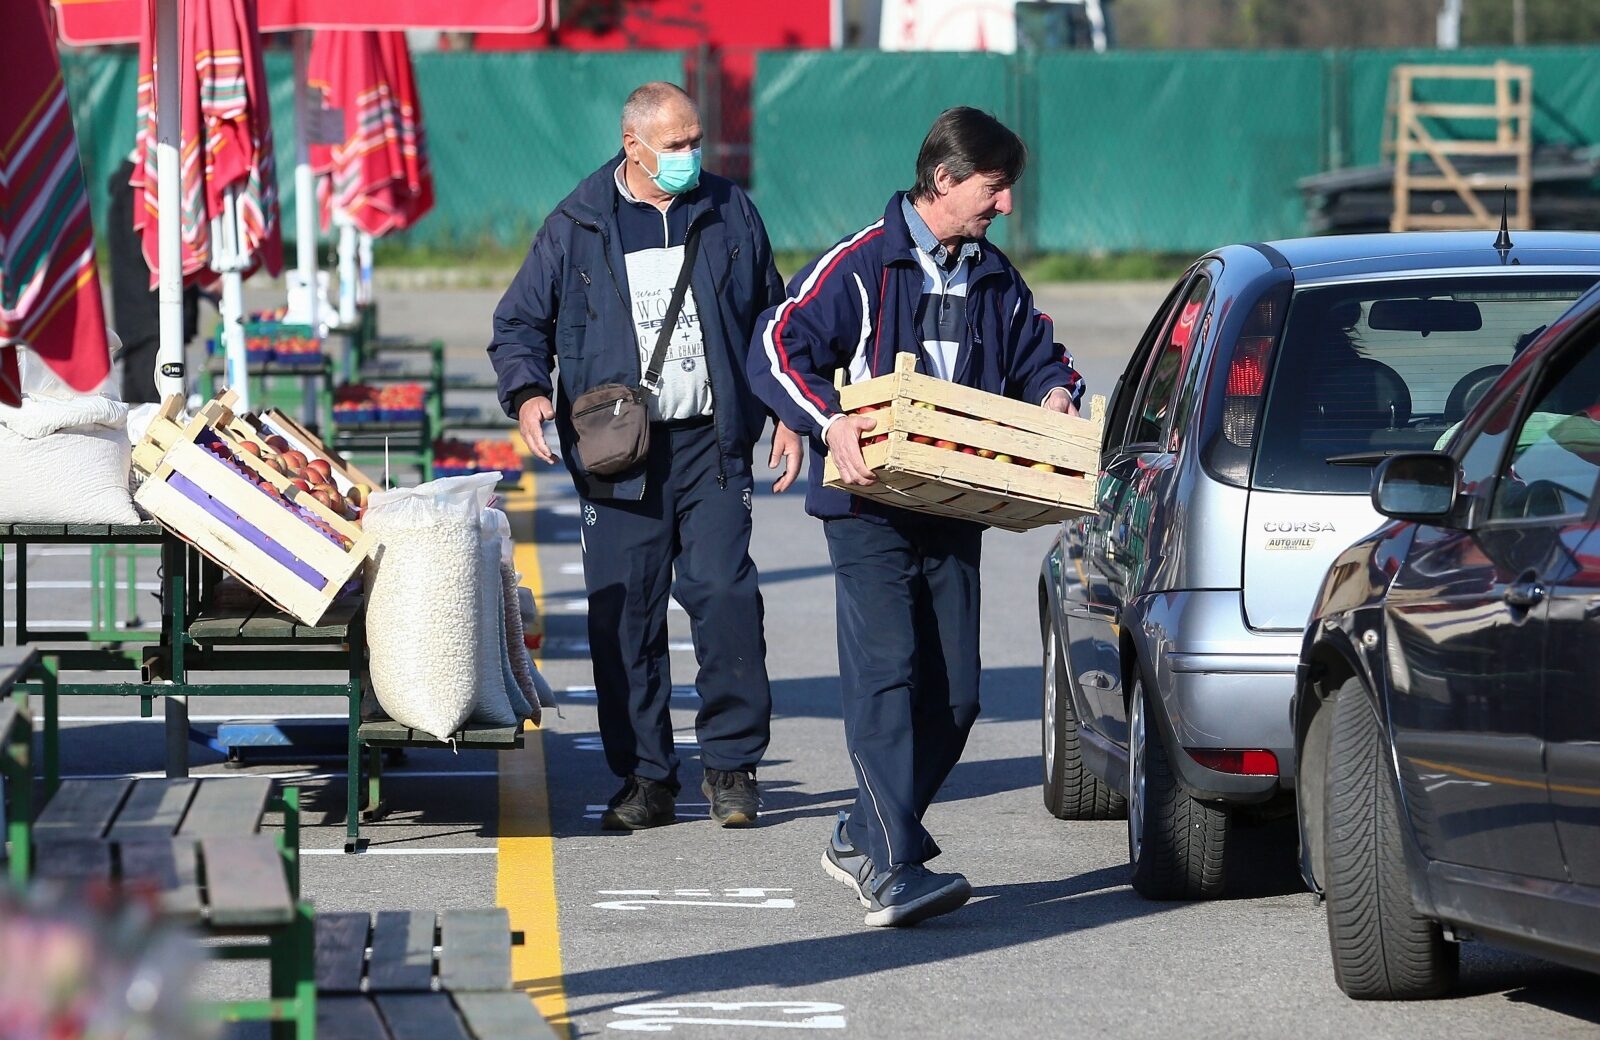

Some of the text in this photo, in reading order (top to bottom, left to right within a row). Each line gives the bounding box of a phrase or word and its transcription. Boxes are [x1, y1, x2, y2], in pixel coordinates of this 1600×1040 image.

[635, 289, 661, 298] West
[678, 342, 704, 358] CHAMPI
[1263, 521, 1336, 533] CORSA
